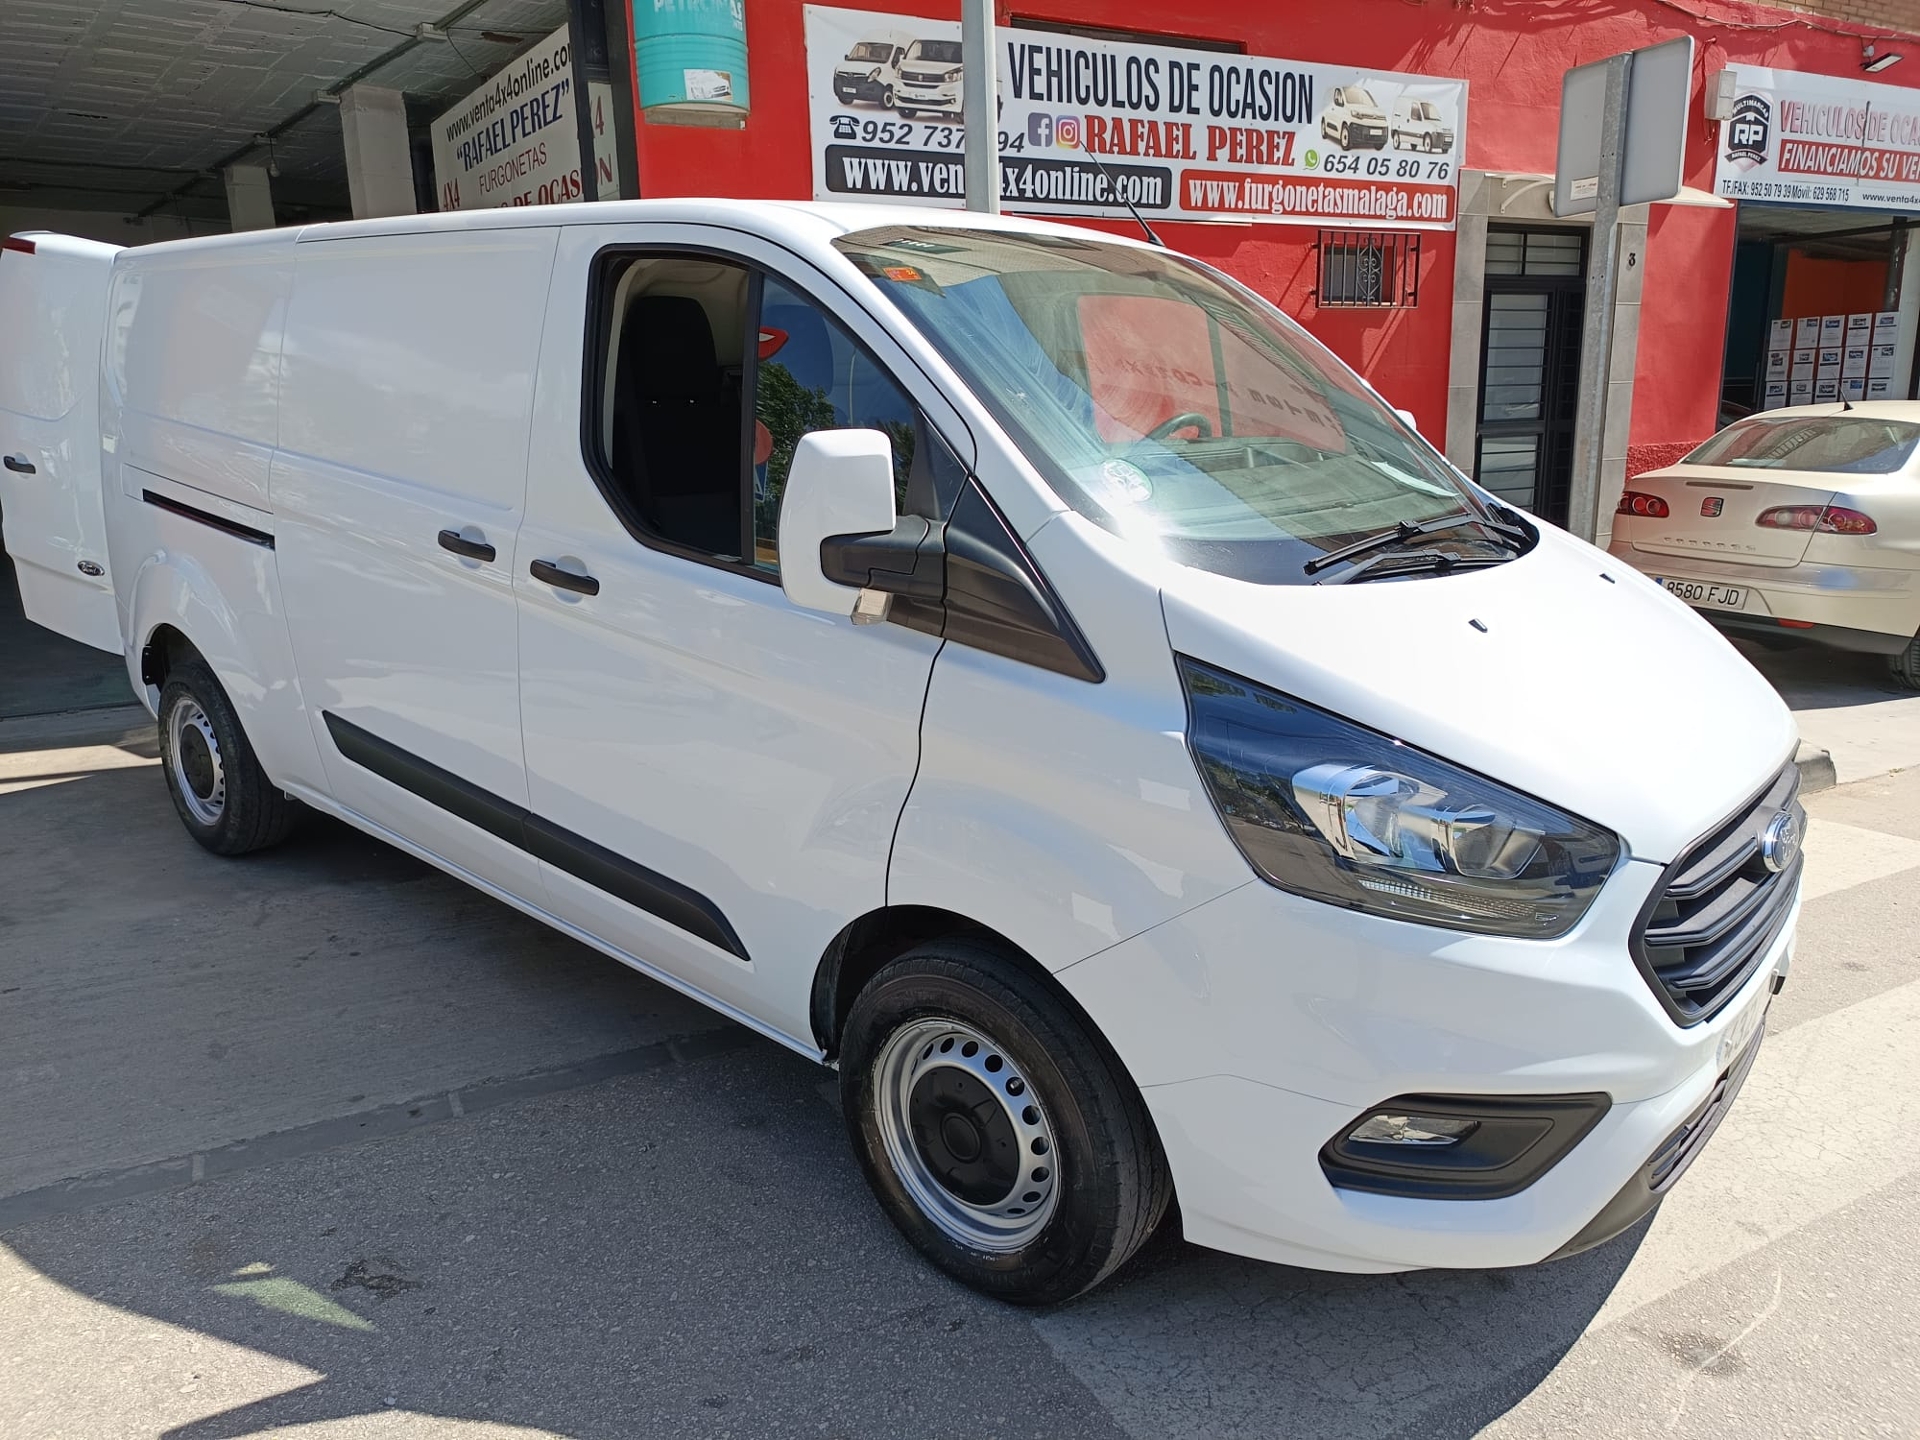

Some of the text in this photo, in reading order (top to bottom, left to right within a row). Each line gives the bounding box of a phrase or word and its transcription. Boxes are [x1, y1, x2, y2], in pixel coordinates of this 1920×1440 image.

[446, 43, 570, 142] www.venta4x4online.co
[1008, 41, 1313, 124] VEHICULOS DE OCASION
[861, 120, 1025, 153] 952 737 94
[1084, 115, 1197, 160] RAFAEL
[1206, 124, 1296, 167] PEREZ
[1734, 124, 1763, 145] RP
[1780, 100, 1920, 146] VEHICULOS DE OCA
[479, 142, 547, 195] FURGONETAS
[843, 156, 1162, 205] www.venx4online.com
[1323, 154, 1450, 180] 654 05 80 76
[1781, 143, 1879, 178] FINANCIAMOS
[1880, 152, 1900, 179] SU
[1189, 178, 1448, 219] www.furgonetasmalaga.com
[1751, 182, 1762, 196] 952
[1764, 183, 1772, 197] 50
[1774, 184, 1782, 198] 79
[1813, 186, 1825, 200] 629
[1838, 188, 1849, 202] 715
[1667, 581, 1740, 606] 8580 FJD
